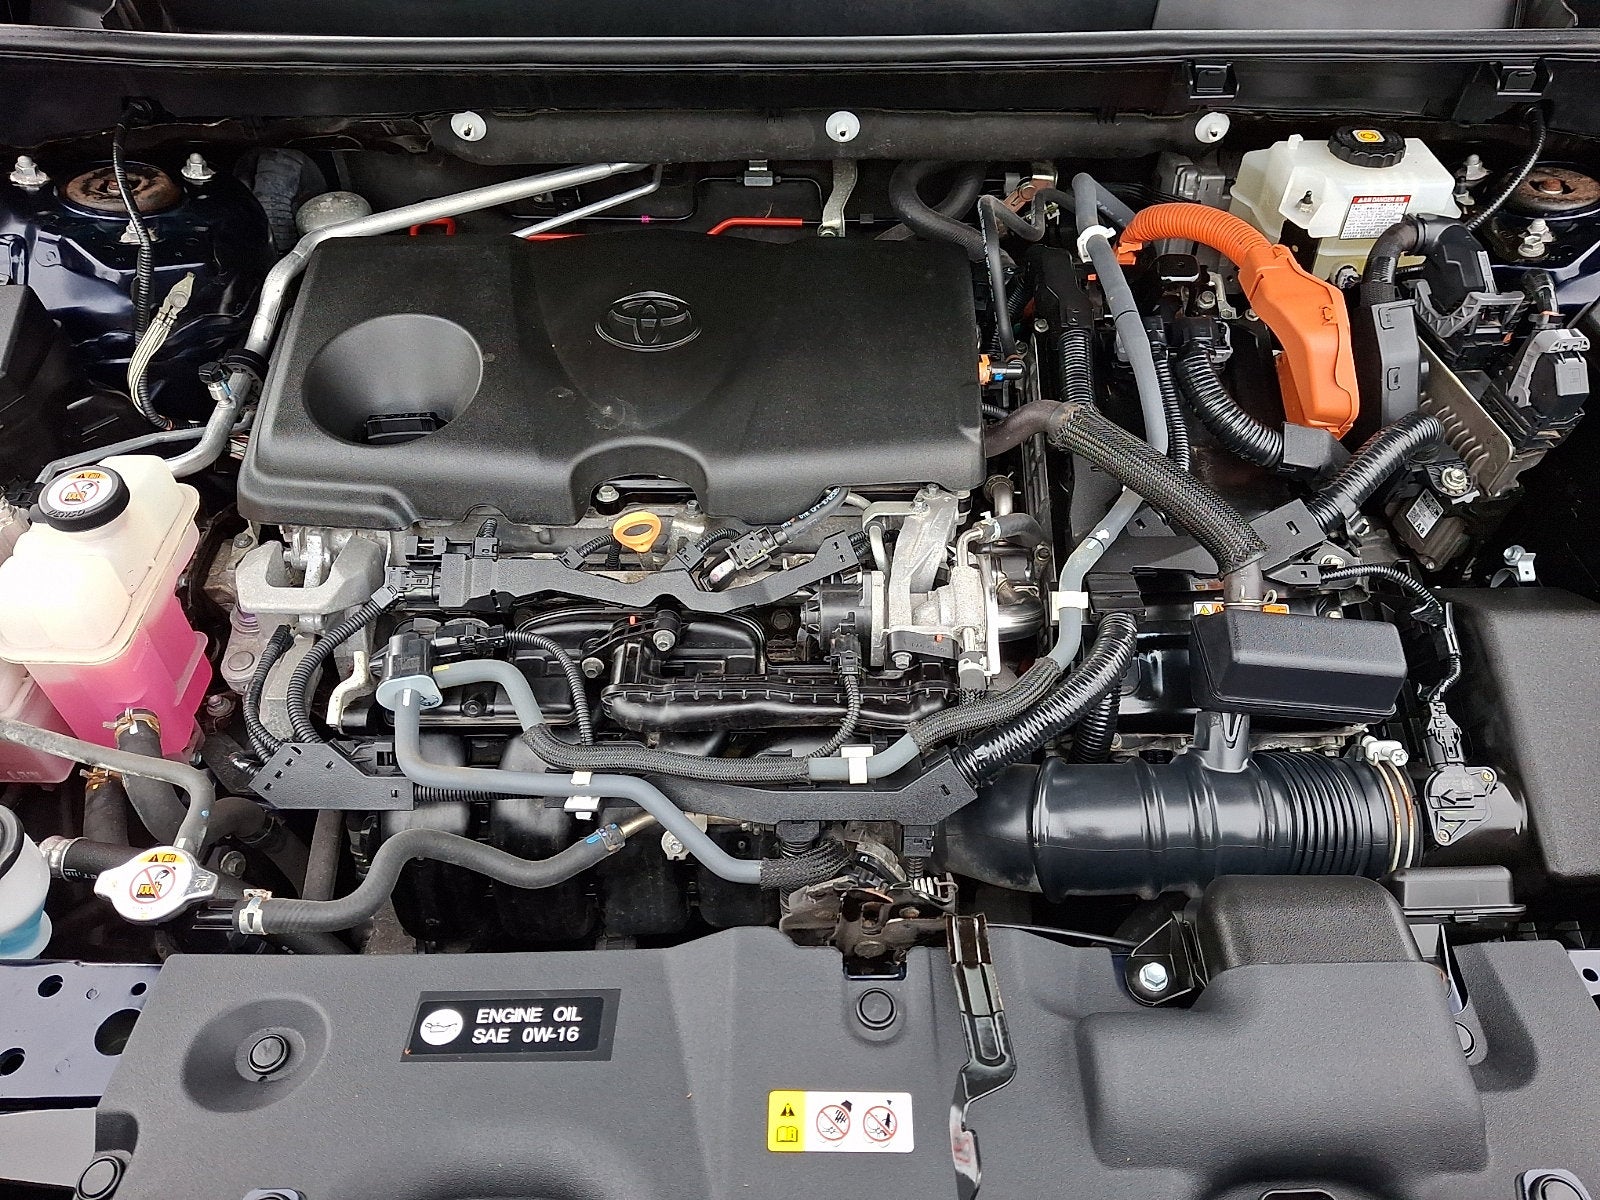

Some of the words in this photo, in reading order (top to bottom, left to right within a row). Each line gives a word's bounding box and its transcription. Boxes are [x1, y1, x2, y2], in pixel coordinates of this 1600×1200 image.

[47, 509, 86, 518] DENSO
[475, 1007, 544, 1024] ENGINE
[552, 1006, 583, 1022] OIL
[471, 1027, 512, 1044] SAE
[521, 1026, 580, 1043] 0W-16
